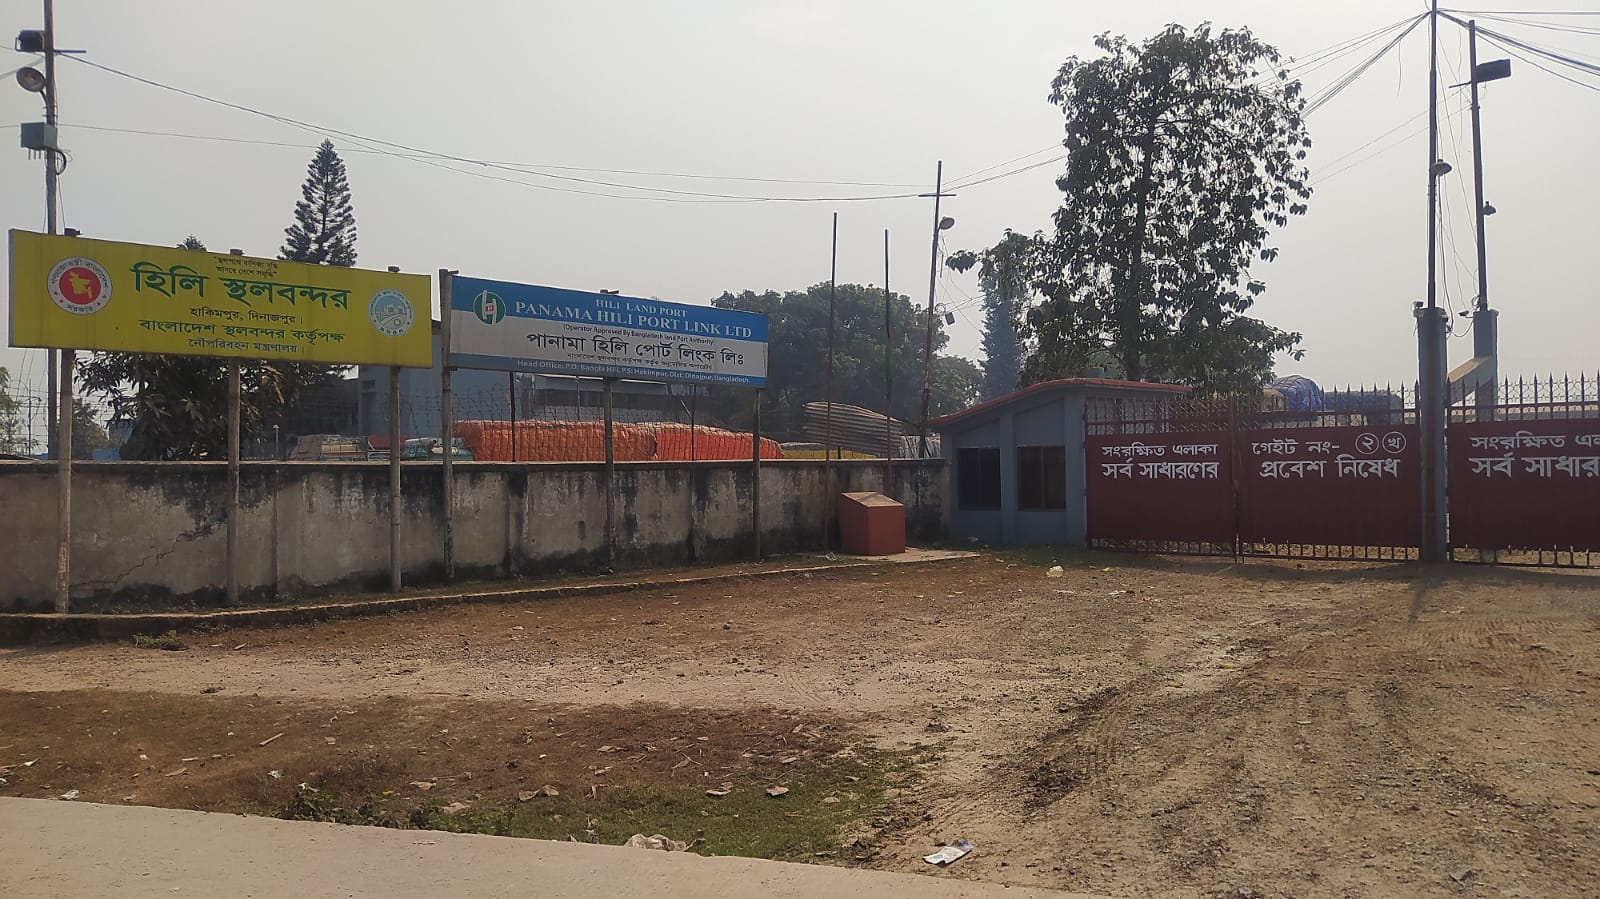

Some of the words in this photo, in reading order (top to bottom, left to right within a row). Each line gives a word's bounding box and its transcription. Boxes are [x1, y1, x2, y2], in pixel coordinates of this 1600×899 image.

[130, 261, 210, 298] হিলি
[218, 276, 353, 311] স্থলবন্দর
[247, 310, 297, 326] দিনাজপুর
[595, 298, 621, 310] HILI
[625, 302, 657, 314] LAND
[659, 306, 688, 318] PORT
[515, 301, 593, 320] PANAMA
[597, 310, 633, 325] HILI
[638, 314, 681, 331] PORT
[684, 320, 721, 335] LINK
[724, 325, 752, 338] LTD
[139, 319, 215, 335] বাংলাদেশ
[222, 323, 286, 340] স্থলবন্দর
[291, 328, 345, 345] কর্তৃপক্ষ
[526, 332, 586, 352] পানামা
[592, 334, 630, 355] হিলি
[635, 341, 674, 358] পোর্ট
[677, 343, 717, 363] লিংক
[517, 360, 538, 368] Head
[1101, 442, 1167, 457] সংরক্ষিত
[1172, 444, 1219, 455] এলাকা
[1251, 438, 1299, 454] গেইট
[1305, 441, 1340, 454] নং-
[1469, 430, 1567, 450] সংরক্ষিত
[1101, 458, 1134, 479] সর্ব
[1138, 461, 1220, 479] সাধারণের
[1259, 460, 1327, 479] প্রবেশ
[1334, 454, 1401, 478] নিষেধ
[1468, 452, 1516, 478] সর্ব
